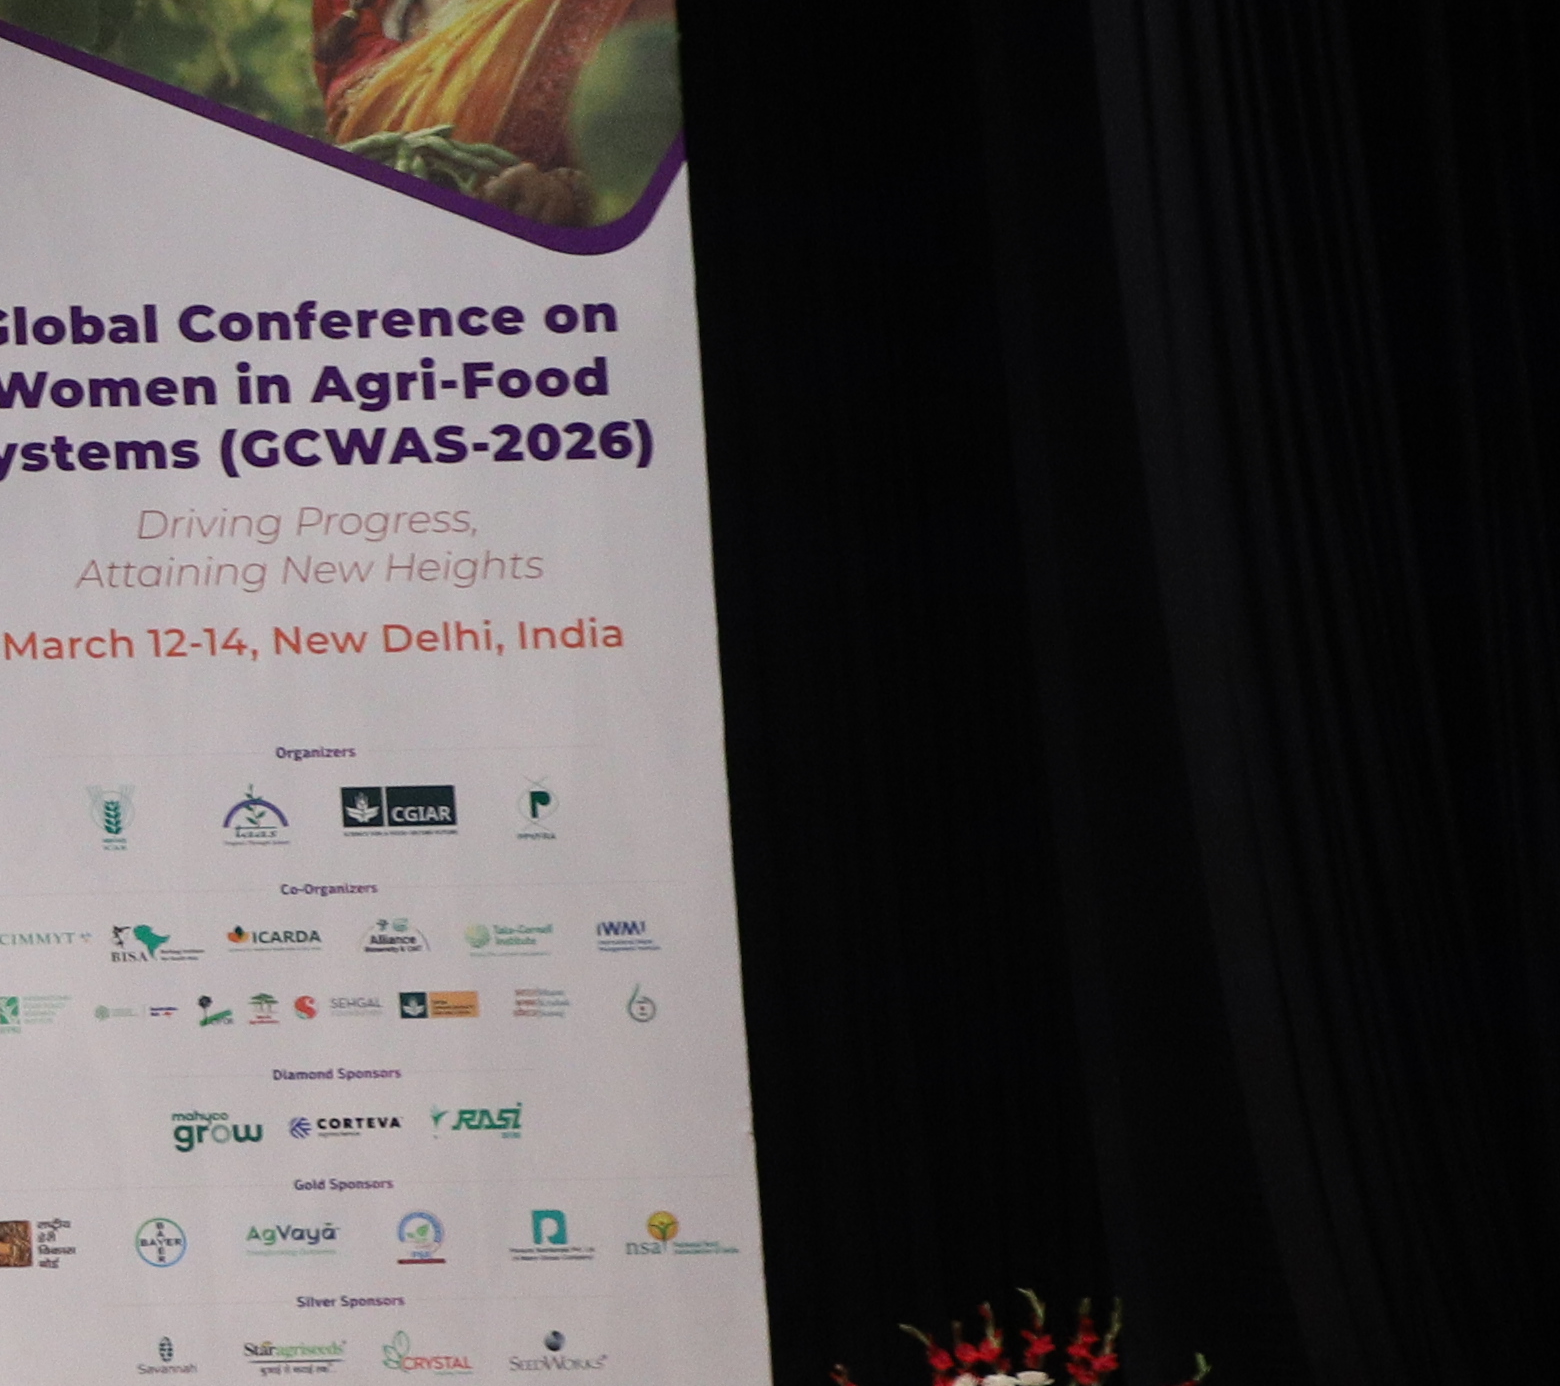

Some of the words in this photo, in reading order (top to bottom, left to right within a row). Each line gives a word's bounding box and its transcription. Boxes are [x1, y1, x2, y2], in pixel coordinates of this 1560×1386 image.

[177, 299, 525, 344] Conference
[543, 302, 618, 335] on
[235, 361, 291, 405] in
[310, 355, 609, 413] Agri-Food
[220, 418, 654, 479] (GCWAS-2026)
[136, 507, 282, 546] Driving
[296, 505, 479, 544] Progress,
[74, 555, 268, 594] Attaining
[281, 554, 375, 585] New
[385, 549, 545, 590] Heights
[3, 628, 135, 661] March
[146, 627, 259, 662] 12-14,
[273, 626, 368, 656] New
[382, 619, 505, 656] Delhi,
[518, 616, 624, 650] India
[274, 746, 357, 763] Organizers
[390, 805, 452, 823] CGIAR
[281, 883, 379, 896] Co-Organizers
[0, 932, 75, 946] CIMMYT
[252, 930, 322, 943] ICARDA
[370, 934, 416, 945] Alliance
[111, 951, 149, 962] BISA
[330, 997, 383, 1010] SEHGAL
[273, 1068, 333, 1080] Diamond
[338, 1068, 402, 1080] Sponsors
[317, 1117, 402, 1130] CORTEVA
[174, 1123, 263, 1152] grow
[294, 1179, 325, 1191] Gold
[329, 1178, 394, 1191] Sponsors
[140, 1238, 183, 1247] BAYER
[297, 1296, 336, 1308] Silver
[341, 1295, 405, 1308] Sponsors
[401, 1355, 473, 1371] CRYSTAL
